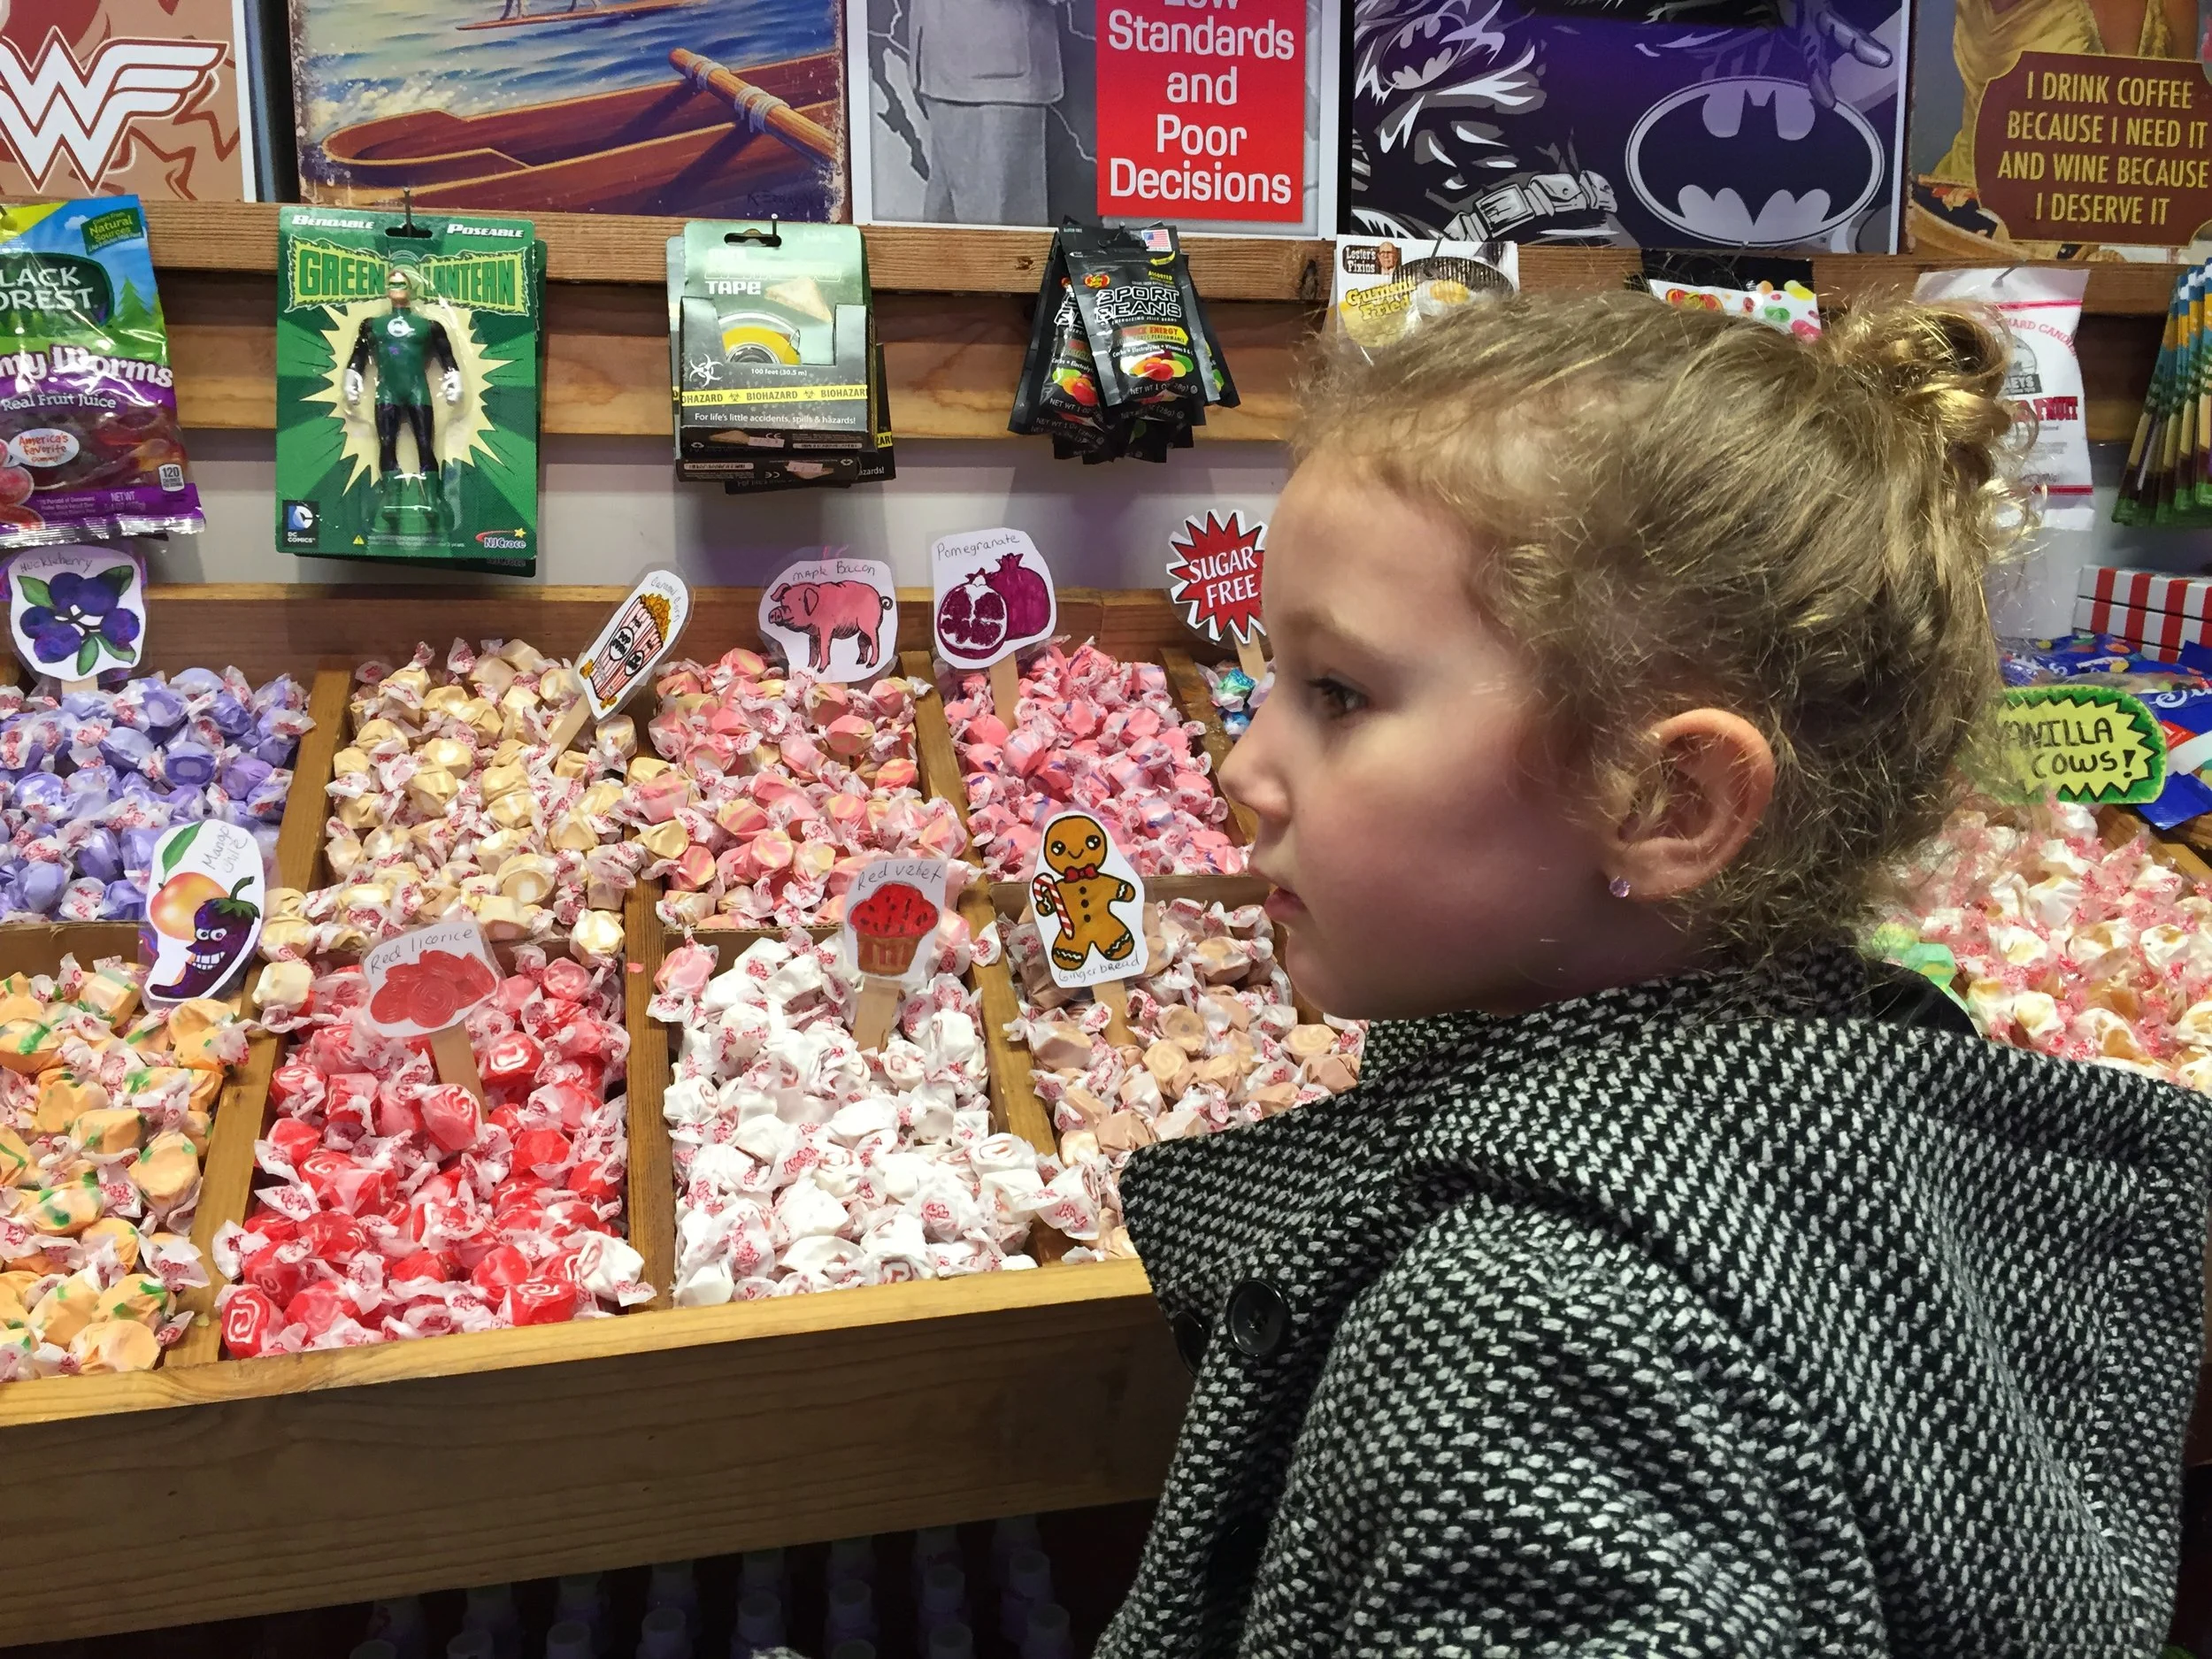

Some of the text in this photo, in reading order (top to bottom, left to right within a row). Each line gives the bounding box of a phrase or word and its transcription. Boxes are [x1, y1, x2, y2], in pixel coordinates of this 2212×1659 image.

[1109, 9, 1294, 60] Standards
[1167, 65, 1237, 105] and
[2026, 71, 2193, 109] I DRINK COFFEE
[1157, 114, 1248, 157] Poor
[2007, 111, 2208, 150] BECAUSE I NEED IT
[1110, 157, 1292, 204] Decisions
[1997, 150, 2209, 188] AND WINE BECAUSE
[2036, 193, 2170, 226] I DESERVE IT
[89, 215, 133, 236] Natural
[447, 223, 526, 238] POSEABLE
[1346, 247, 1377, 260] Lester's
[0, 265, 81, 288] LACK
[299, 249, 516, 306] GREEN LANTERN
[1347, 260, 1376, 273] Fixins
[0, 287, 94, 311] OREST
[1096, 286, 1179, 304] SPORT
[1094, 301, 1182, 323] BEANS
[0, 345, 173, 388] my Worms
[2, 394, 117, 411] Real Fruit Juice
[682, 388, 868, 403] OHAZARD BIOHAZARD BIOHAZAR
[1049, 398, 1063, 407] NET
[1130, 387, 1142, 396] NET
[729, 413, 748, 422] little
[749, 414, 791, 423] accidents,
[822, 415, 856, 425] hazards!
[19, 432, 69, 447] America's
[22, 443, 67, 457] Favorite
[162, 467, 180, 478] 120
[858, 465, 885, 476] azards!
[111, 491, 135, 502] NET WT
[484, 536, 526, 549] NJCroce
[937, 533, 1020, 561] Pomegranate
[836, 561, 875, 576] Bacon
[1189, 546, 1257, 584] SUGAR
[1206, 574, 1259, 609] FREE
[2002, 718, 2115, 749] ANILLA
[202, 826, 231, 870] Mango
[857, 861, 887, 891] Red
[371, 928, 474, 974] Red licorice
